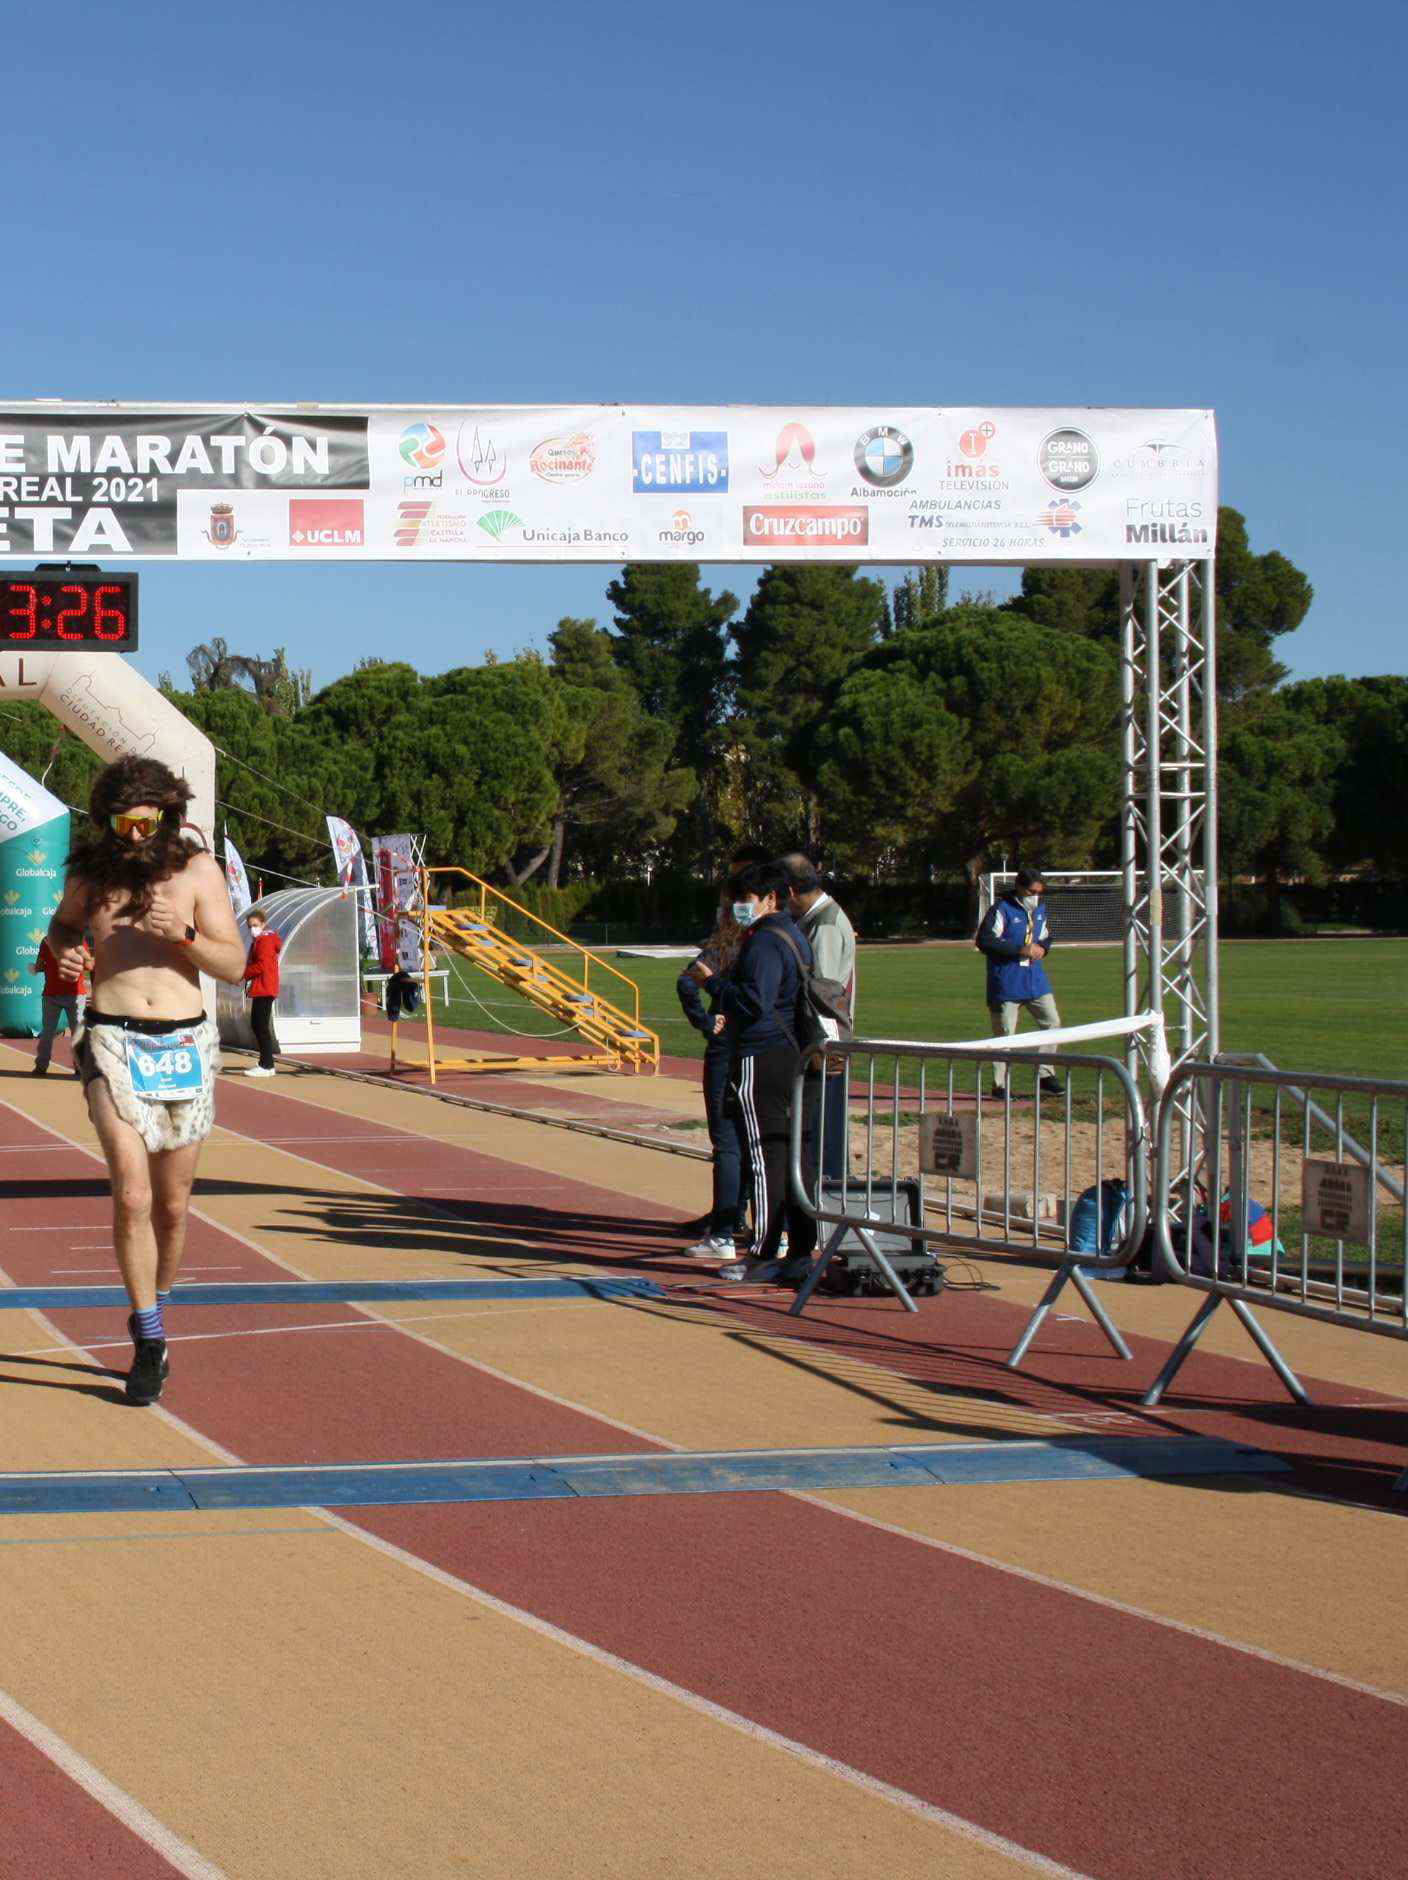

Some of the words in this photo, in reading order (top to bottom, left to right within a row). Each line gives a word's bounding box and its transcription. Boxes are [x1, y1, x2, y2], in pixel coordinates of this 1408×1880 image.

[45, 424, 331, 475] MARATÓN
[642, 453, 720, 485] CENFIS
[91, 478, 160, 503] 2021
[403, 470, 443, 495] pmd
[908, 499, 1002, 511] AMBULANCIAS
[1125, 498, 1203, 518] Frutas
[749, 512, 862, 539] Cruzcampo
[907, 514, 944, 529] TMS
[308, 529, 361, 544] UCLM
[522, 527, 581, 544] Unicaja
[583, 528, 629, 543] Banco
[659, 529, 705, 546] margo
[942, 537, 990, 548] SERVICIO
[1125, 522, 1209, 544] Millán
[59, 693, 106, 738] CIUDAD
[15, 867, 58, 879] Globalcaja
[15, 945, 40, 956] Globa
[137, 1051, 192, 1077] 648
